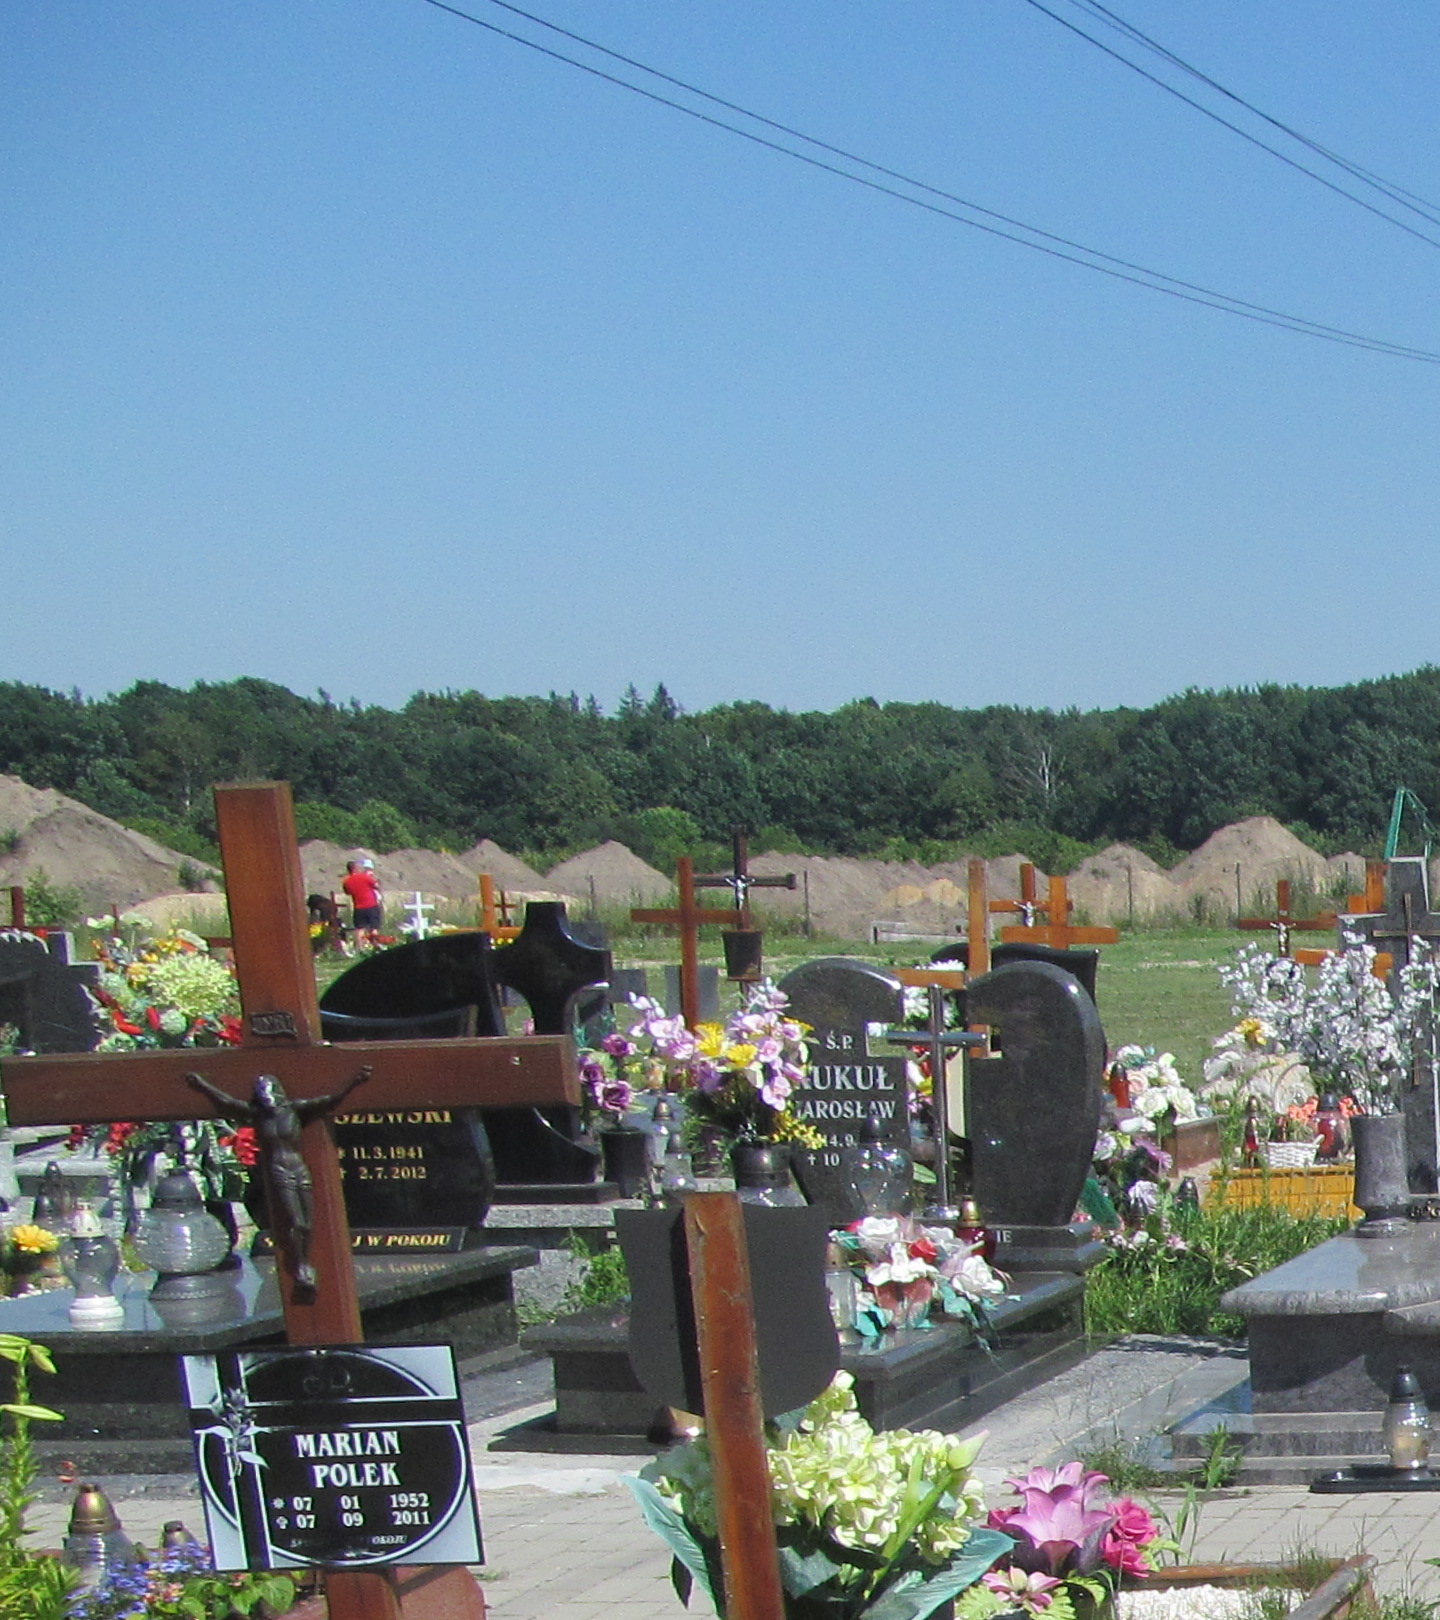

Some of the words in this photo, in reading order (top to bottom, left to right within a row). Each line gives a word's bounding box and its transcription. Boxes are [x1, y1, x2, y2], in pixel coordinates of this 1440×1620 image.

[826, 1030, 853, 1050] Ś.P.
[334, 1110, 452, 1125] SZEWSKI
[353, 1146, 424, 1160] 11.3.1941
[366, 1236, 382, 1247] W
[386, 1234, 452, 1248] POKOJU
[295, 1430, 402, 1458] MARIAN
[313, 1462, 402, 1489] POLEK
[293, 1496, 313, 1512] 07
[341, 1494, 361, 1510] 01
[390, 1492, 430, 1509] 1952
[296, 1514, 316, 1530] 07
[343, 1512, 364, 1528] 09
[393, 1511, 430, 1527] 2011
